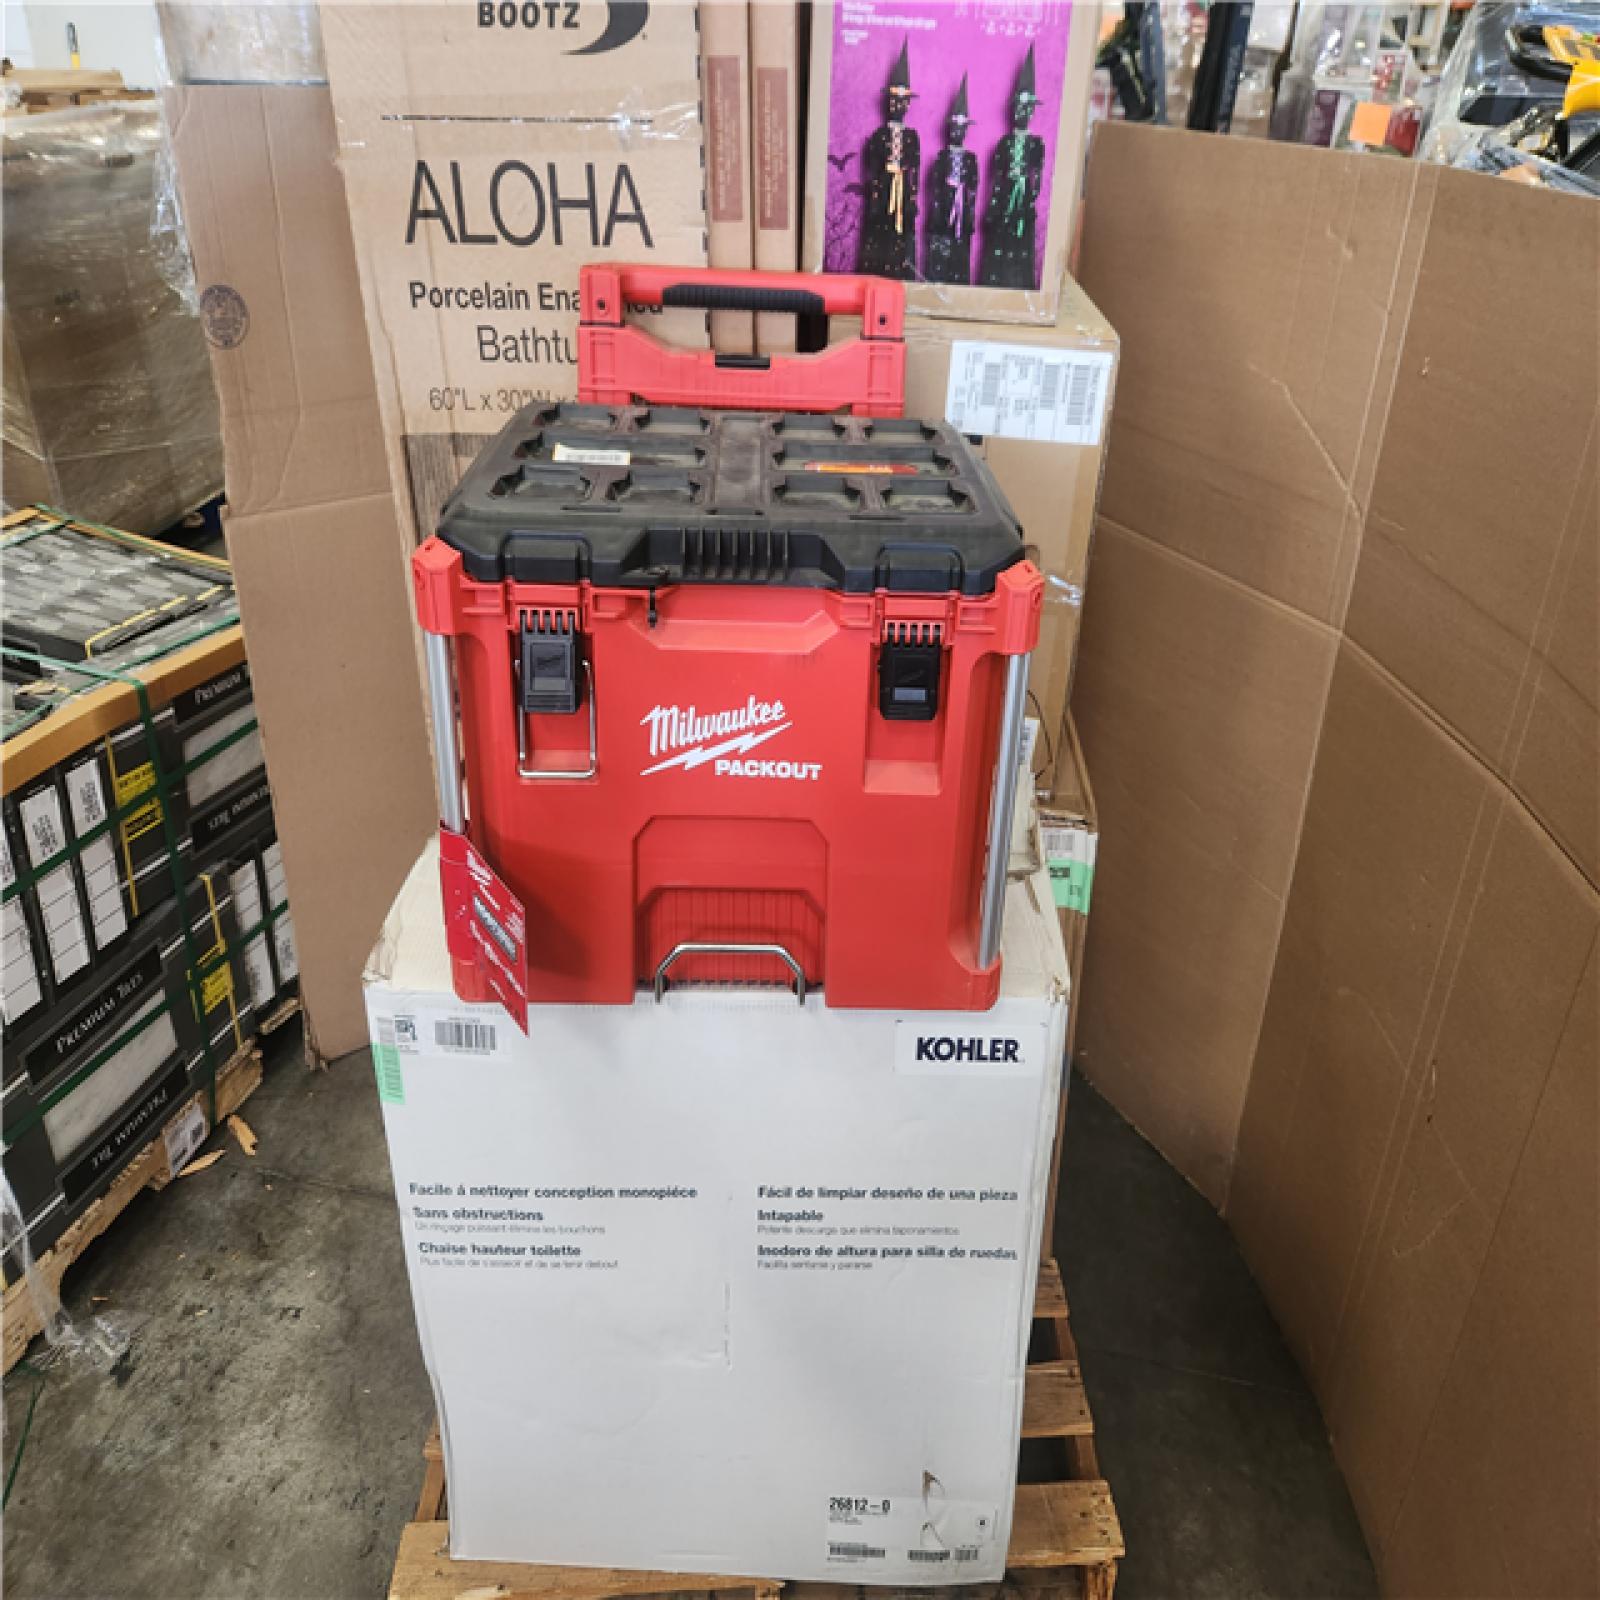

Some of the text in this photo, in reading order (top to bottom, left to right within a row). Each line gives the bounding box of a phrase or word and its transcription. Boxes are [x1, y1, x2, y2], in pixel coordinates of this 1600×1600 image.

[477, 1, 580, 28] BOOTZ
[405, 160, 655, 249] ALOHA
[409, 281, 529, 311] Porcelain
[428, 387, 476, 412] 60"L
[639, 694, 786, 757] Milwaukee
[714, 759, 822, 781] PACKOUT
[916, 1037, 1020, 1063] KOHLER
[409, 1182, 453, 1196] Facile
[469, 1184, 530, 1200] nettoyer
[534, 1185, 616, 1201] conception
[757, 1185, 793, 1198] Fácil
[796, 1187, 814, 1198] de
[817, 1187, 867, 1201] limpiar
[926, 1188, 945, 1200] de
[949, 1190, 976, 1201] una
[979, 1188, 1018, 1203] pieza
[412, 1207, 545, 1221] Sans obstructions
[757, 1209, 824, 1223] Intapable
[418, 1242, 581, 1256] Chaise hauteur toilette
[757, 1245, 1018, 1260] Inodoro de altura para silla de ruedas
